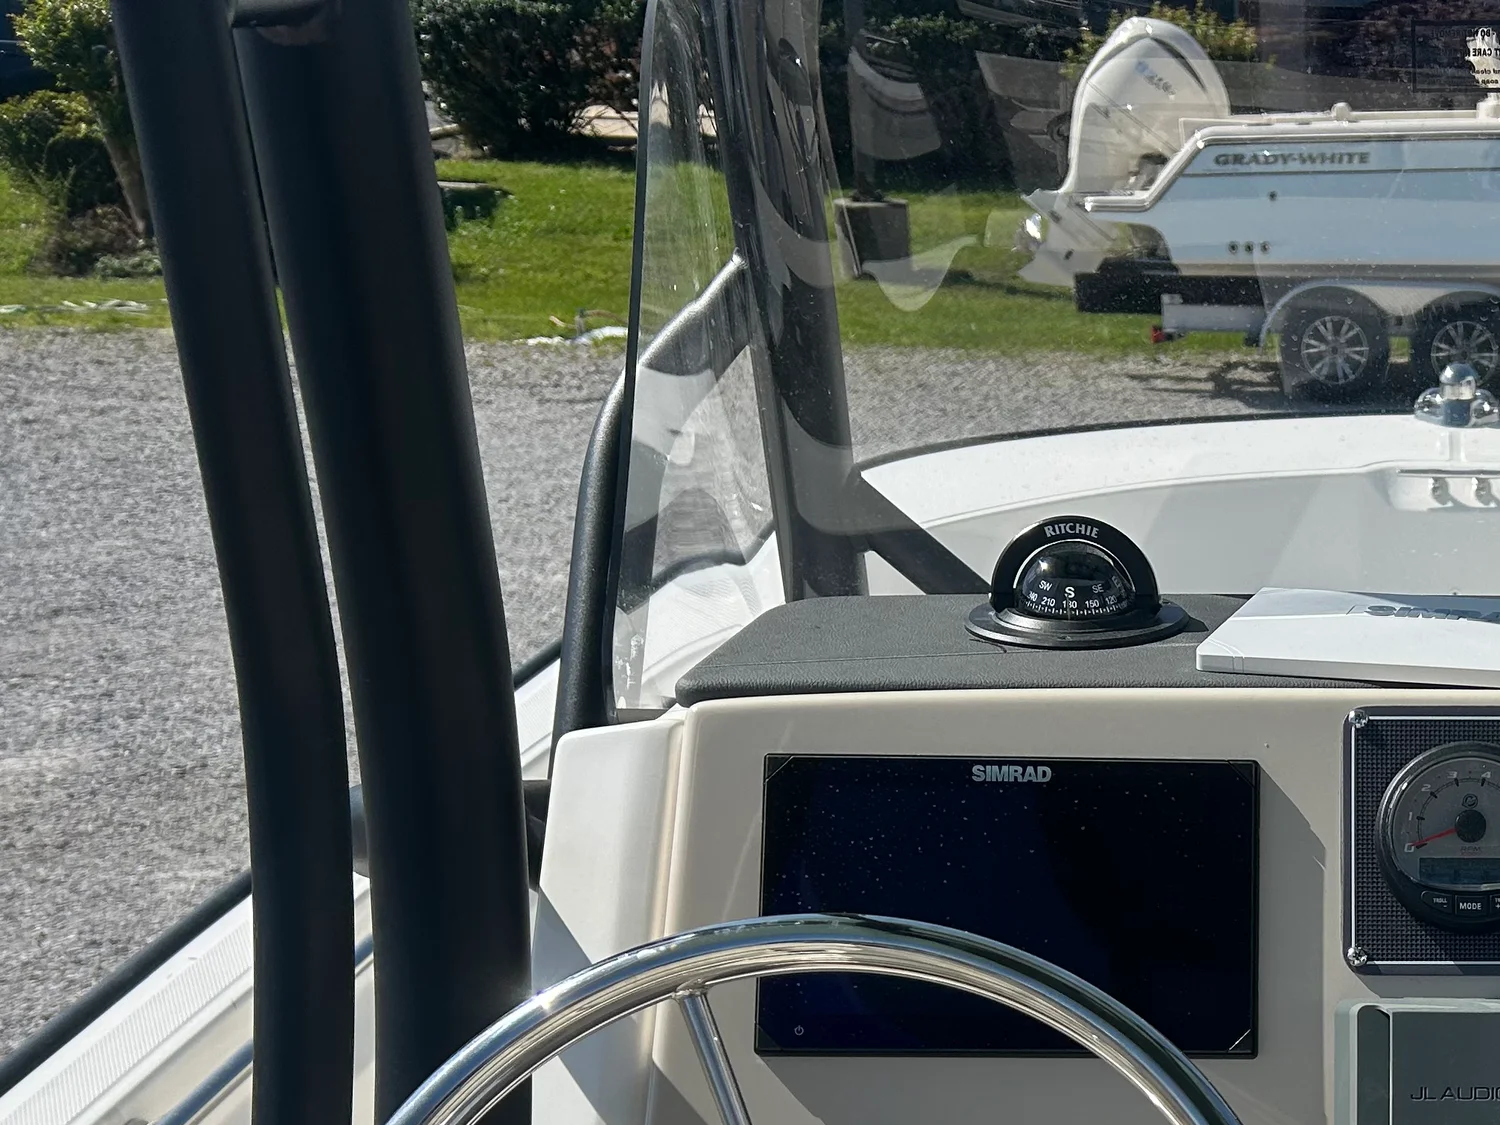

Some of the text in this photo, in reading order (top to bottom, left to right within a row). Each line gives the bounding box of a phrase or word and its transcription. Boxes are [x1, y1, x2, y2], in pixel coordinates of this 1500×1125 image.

[1213, 152, 1370, 166] GRADY-WHITE
[1044, 522, 1100, 539] RITCHIE
[1039, 580, 1105, 599] SW S SE
[1041, 596, 1056, 607] 210
[1084, 599, 1100, 609] 150
[1105, 595, 1118, 605] 120
[972, 764, 1053, 782] SIMRAD
[1448, 771, 1458, 779] 3
[1481, 771, 1491, 779] 4
[1421, 784, 1431, 792] 2
[1408, 812, 1413, 820] 1
[1459, 902, 1482, 911] MODE
[1410, 1086, 1438, 1102] JL
